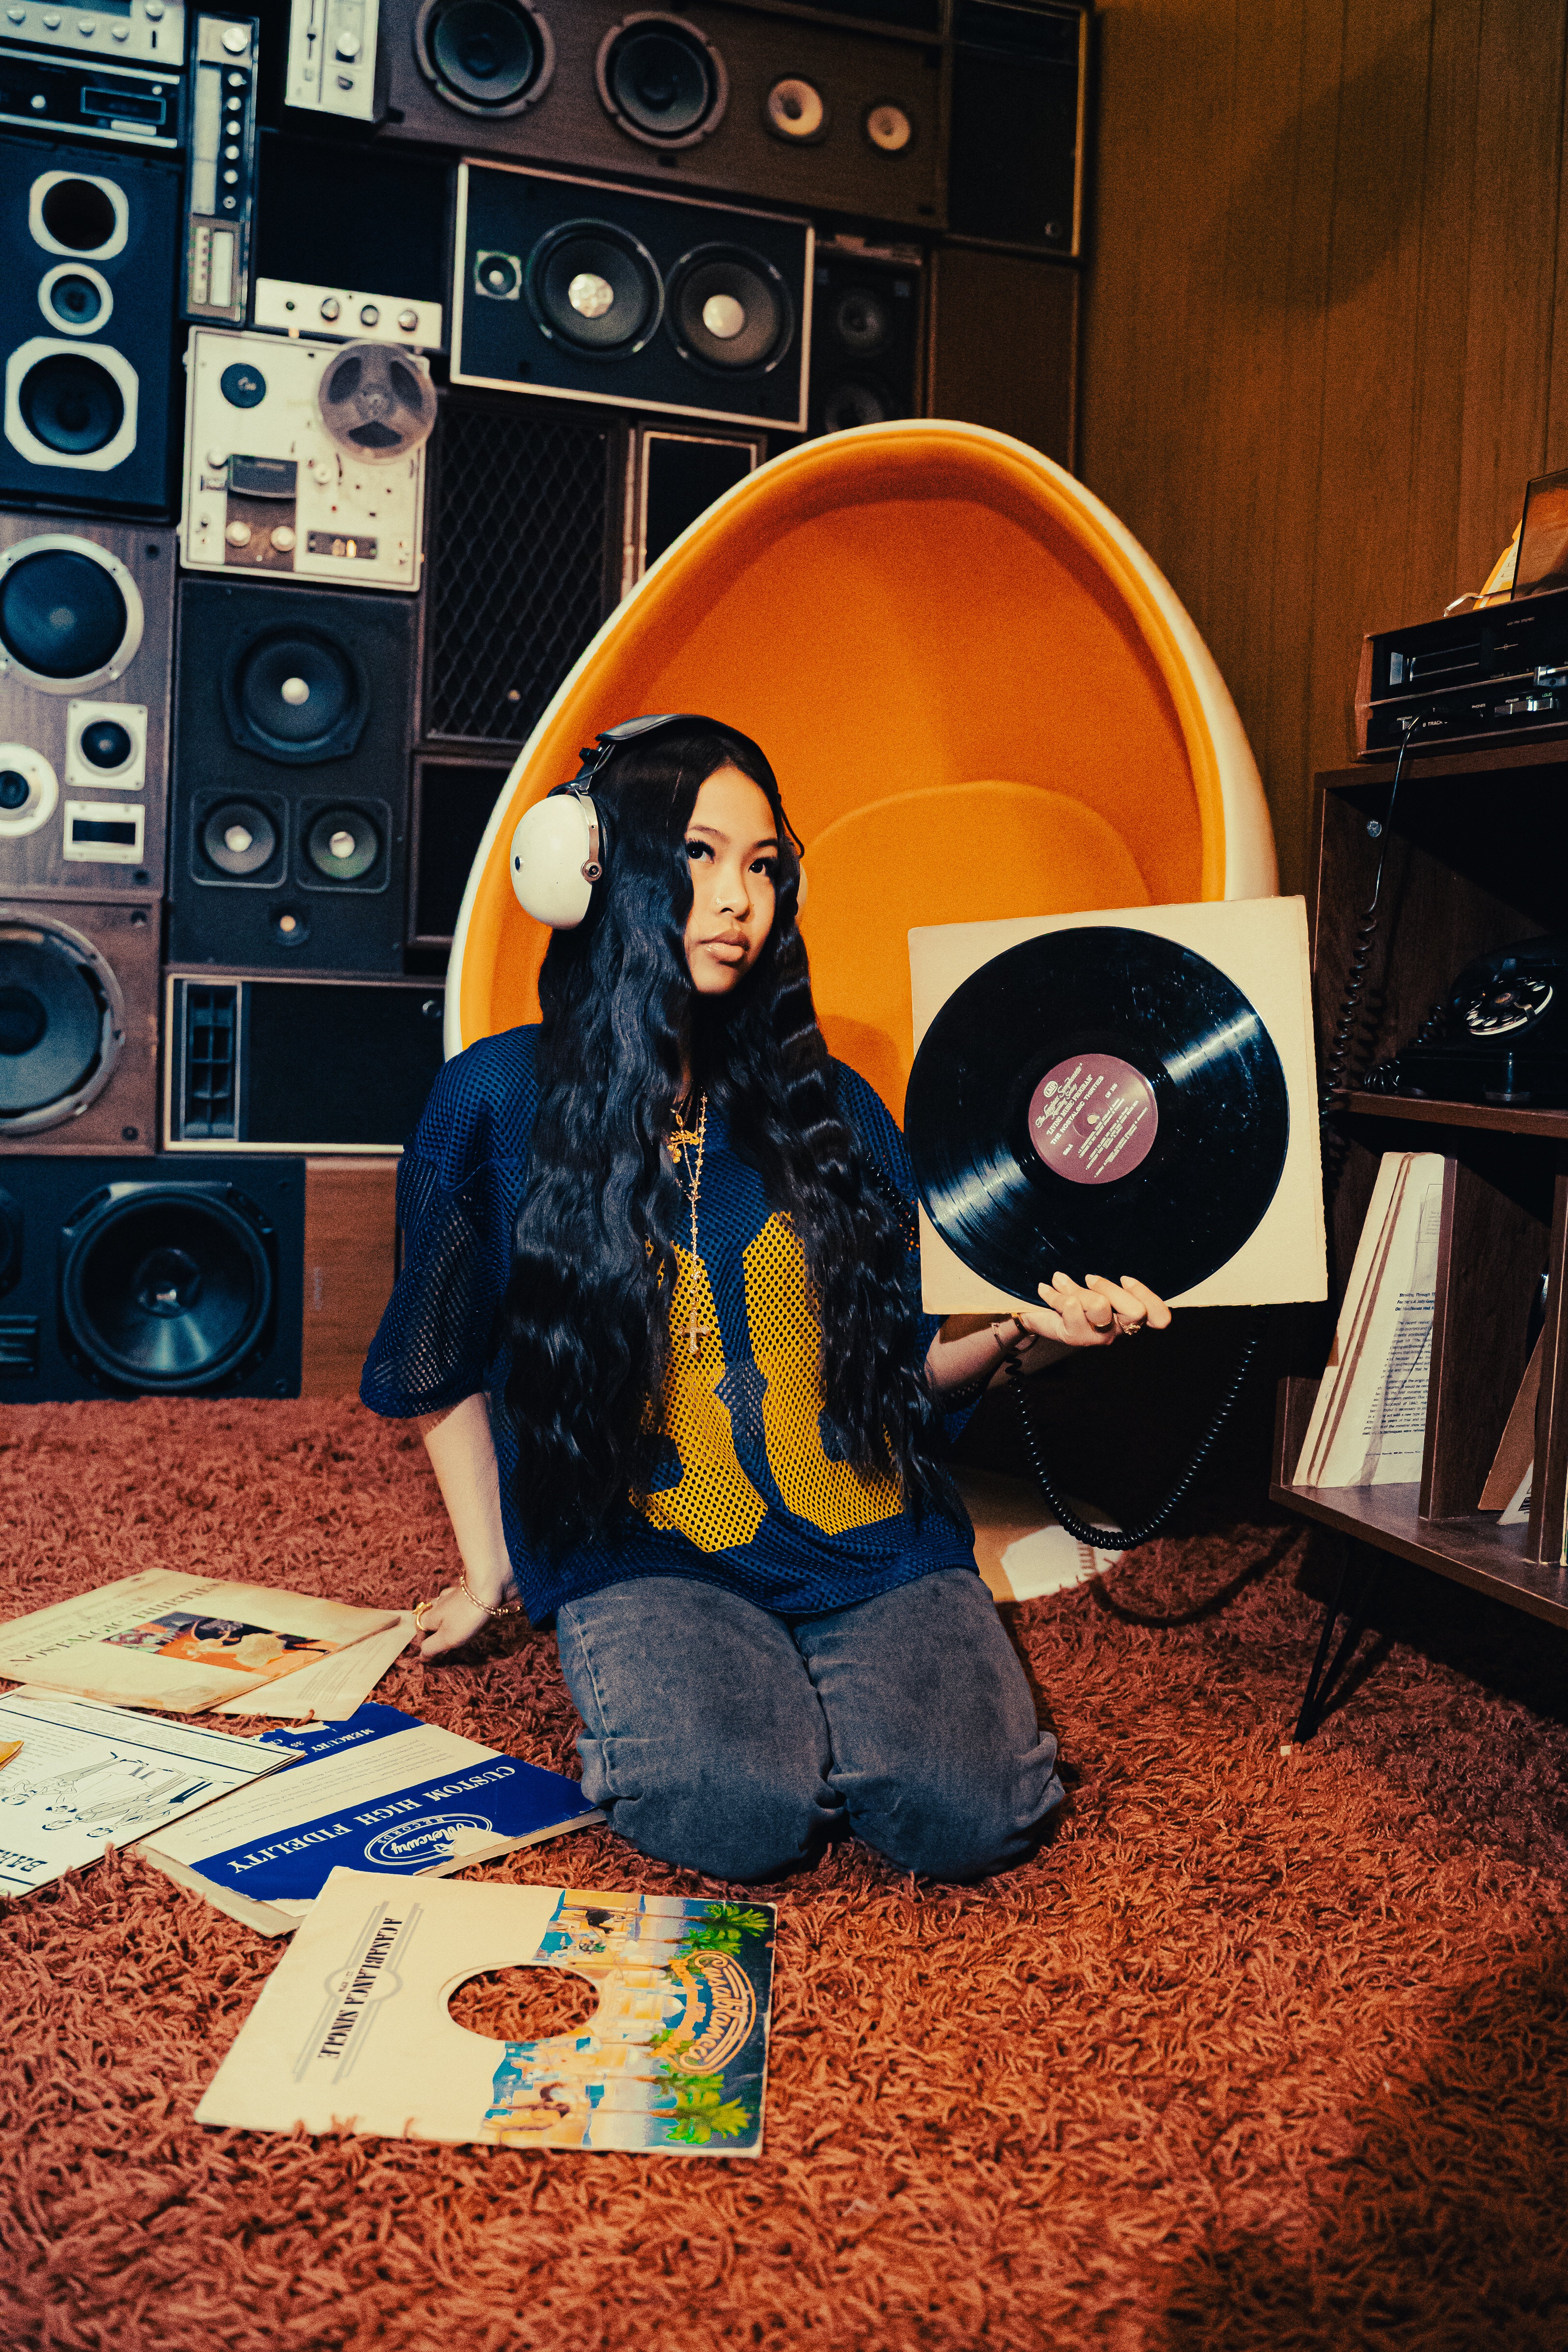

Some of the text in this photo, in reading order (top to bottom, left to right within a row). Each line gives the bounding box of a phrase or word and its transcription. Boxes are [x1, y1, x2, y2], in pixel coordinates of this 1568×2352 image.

[1051, 1133, 1061, 1144] THE
[1061, 1101, 1084, 1132] NOSTALGIC
[1084, 1076, 1104, 1100] THIRTIES
[1061, 1100, 1074, 1116] MUSIC
[9, 1619, 123, 1666] NOSTALGIC
[310, 1728, 375, 1753] MERCURY
[227, 1766, 516, 1874] CUSTOM HIGH FIDELITY
[379, 1816, 446, 1845] RECORDS
[393, 1823, 465, 1855] Mercury
[0, 1849, 49, 1873] BAR
[344, 1927, 398, 2005] CASABLANCA
[317, 2010, 359, 2059] SINGLE
[681, 1954, 748, 2068] Casablanca
